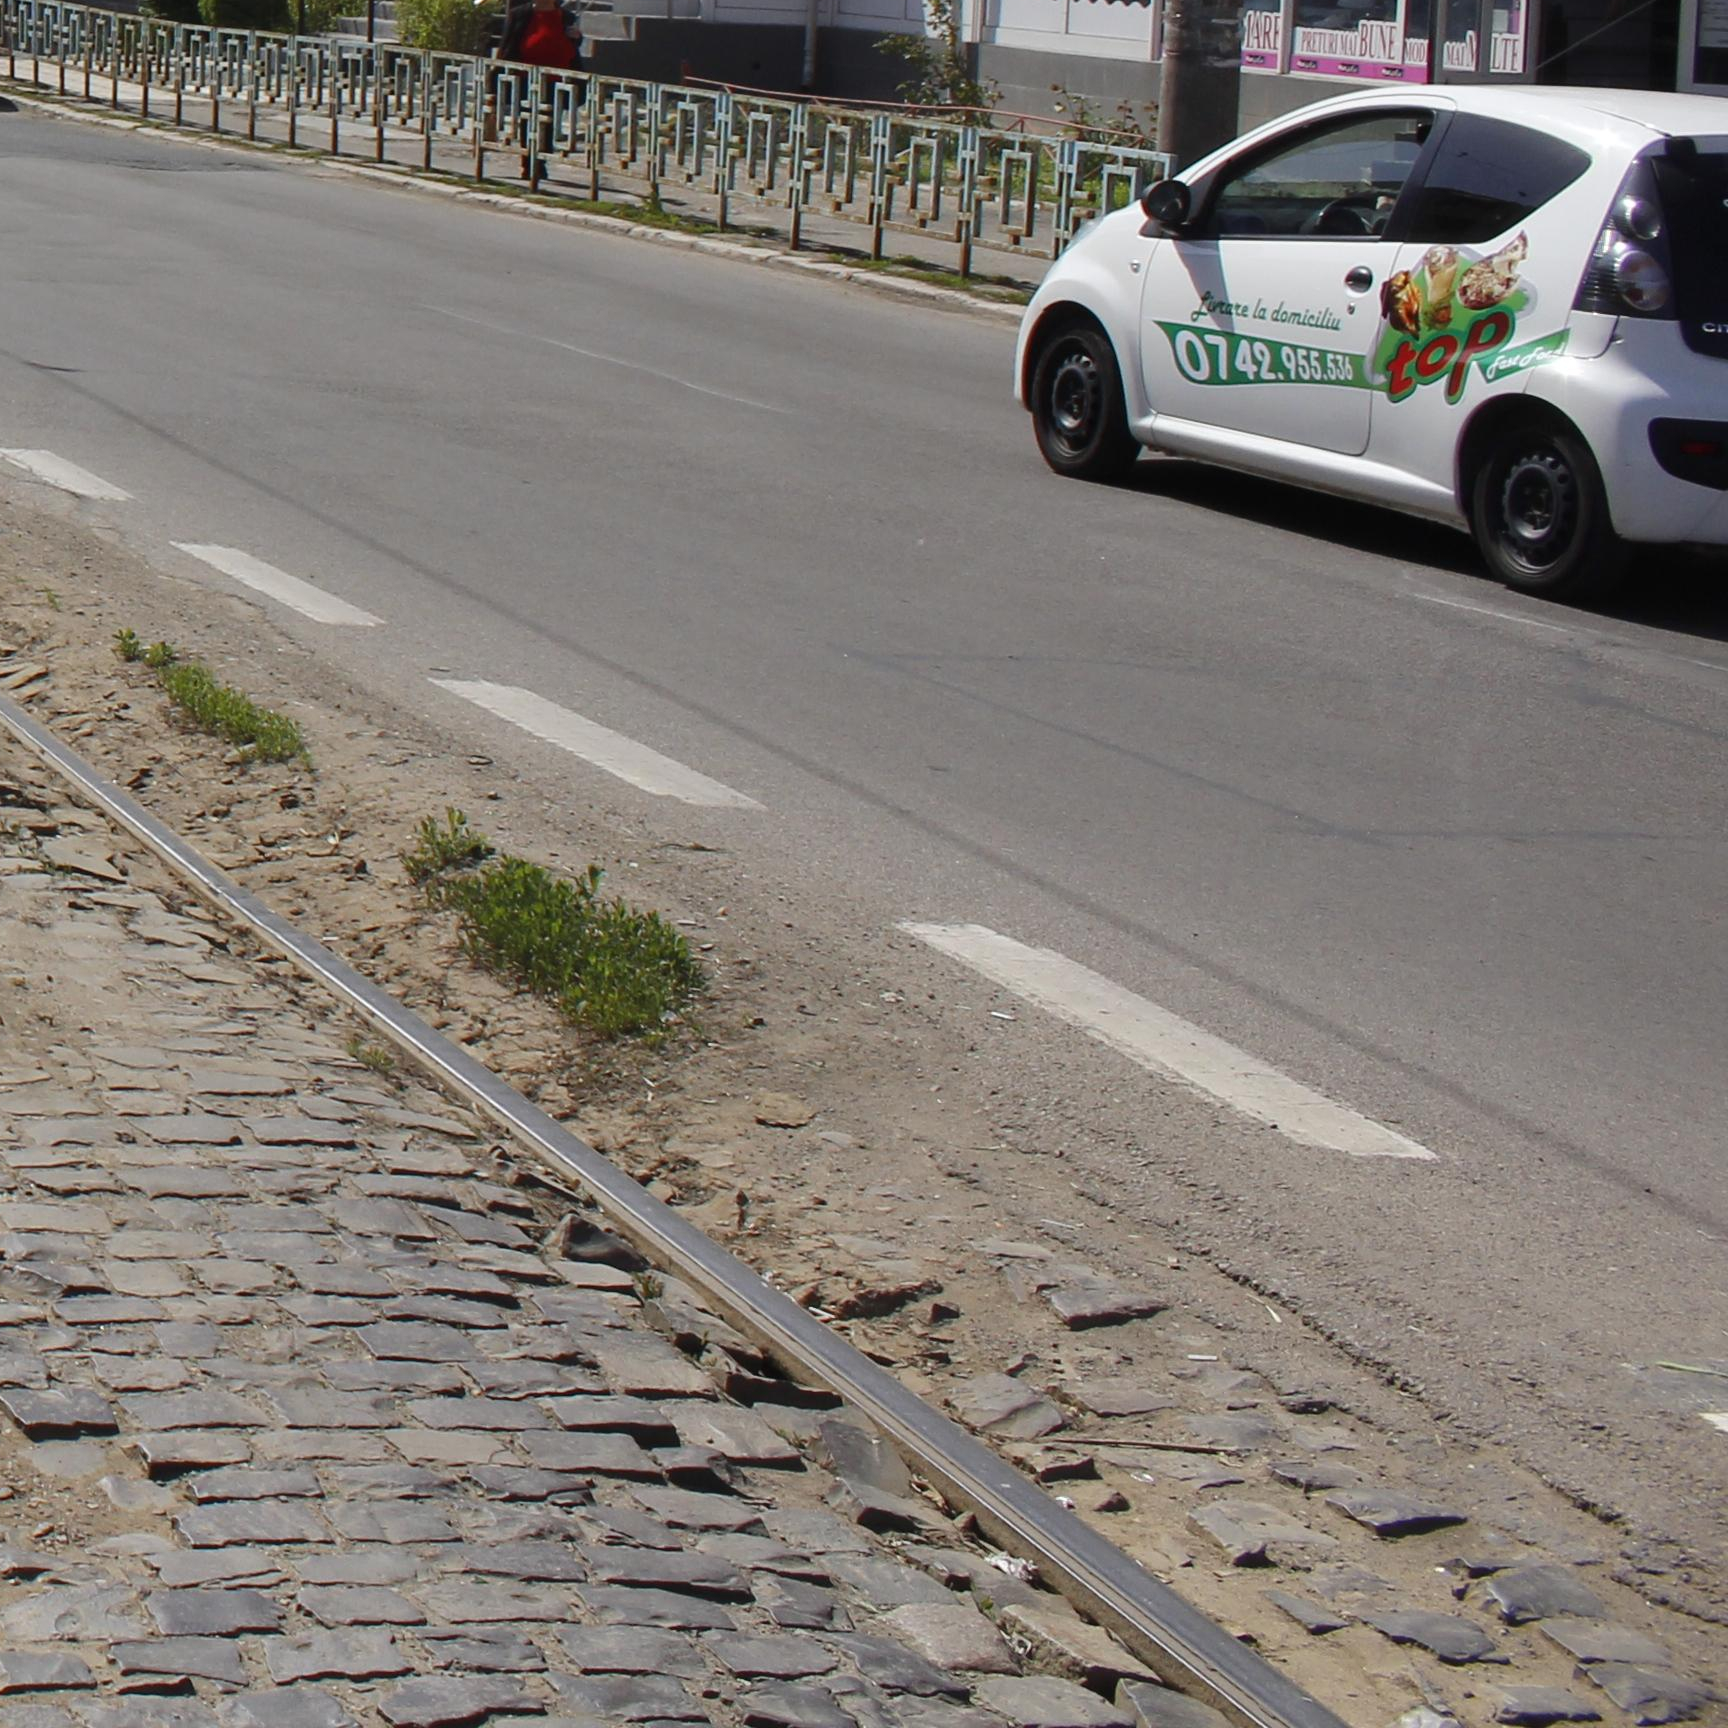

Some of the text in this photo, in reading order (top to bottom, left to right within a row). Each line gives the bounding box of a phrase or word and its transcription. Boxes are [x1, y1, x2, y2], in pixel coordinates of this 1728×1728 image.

[1359, 22, 1397, 60] BUNE
[1191, 291, 1342, 331] Livrare la domiciliu
[1175, 329, 1353, 382] 0742.955.536
[1386, 311, 1511, 398] top
